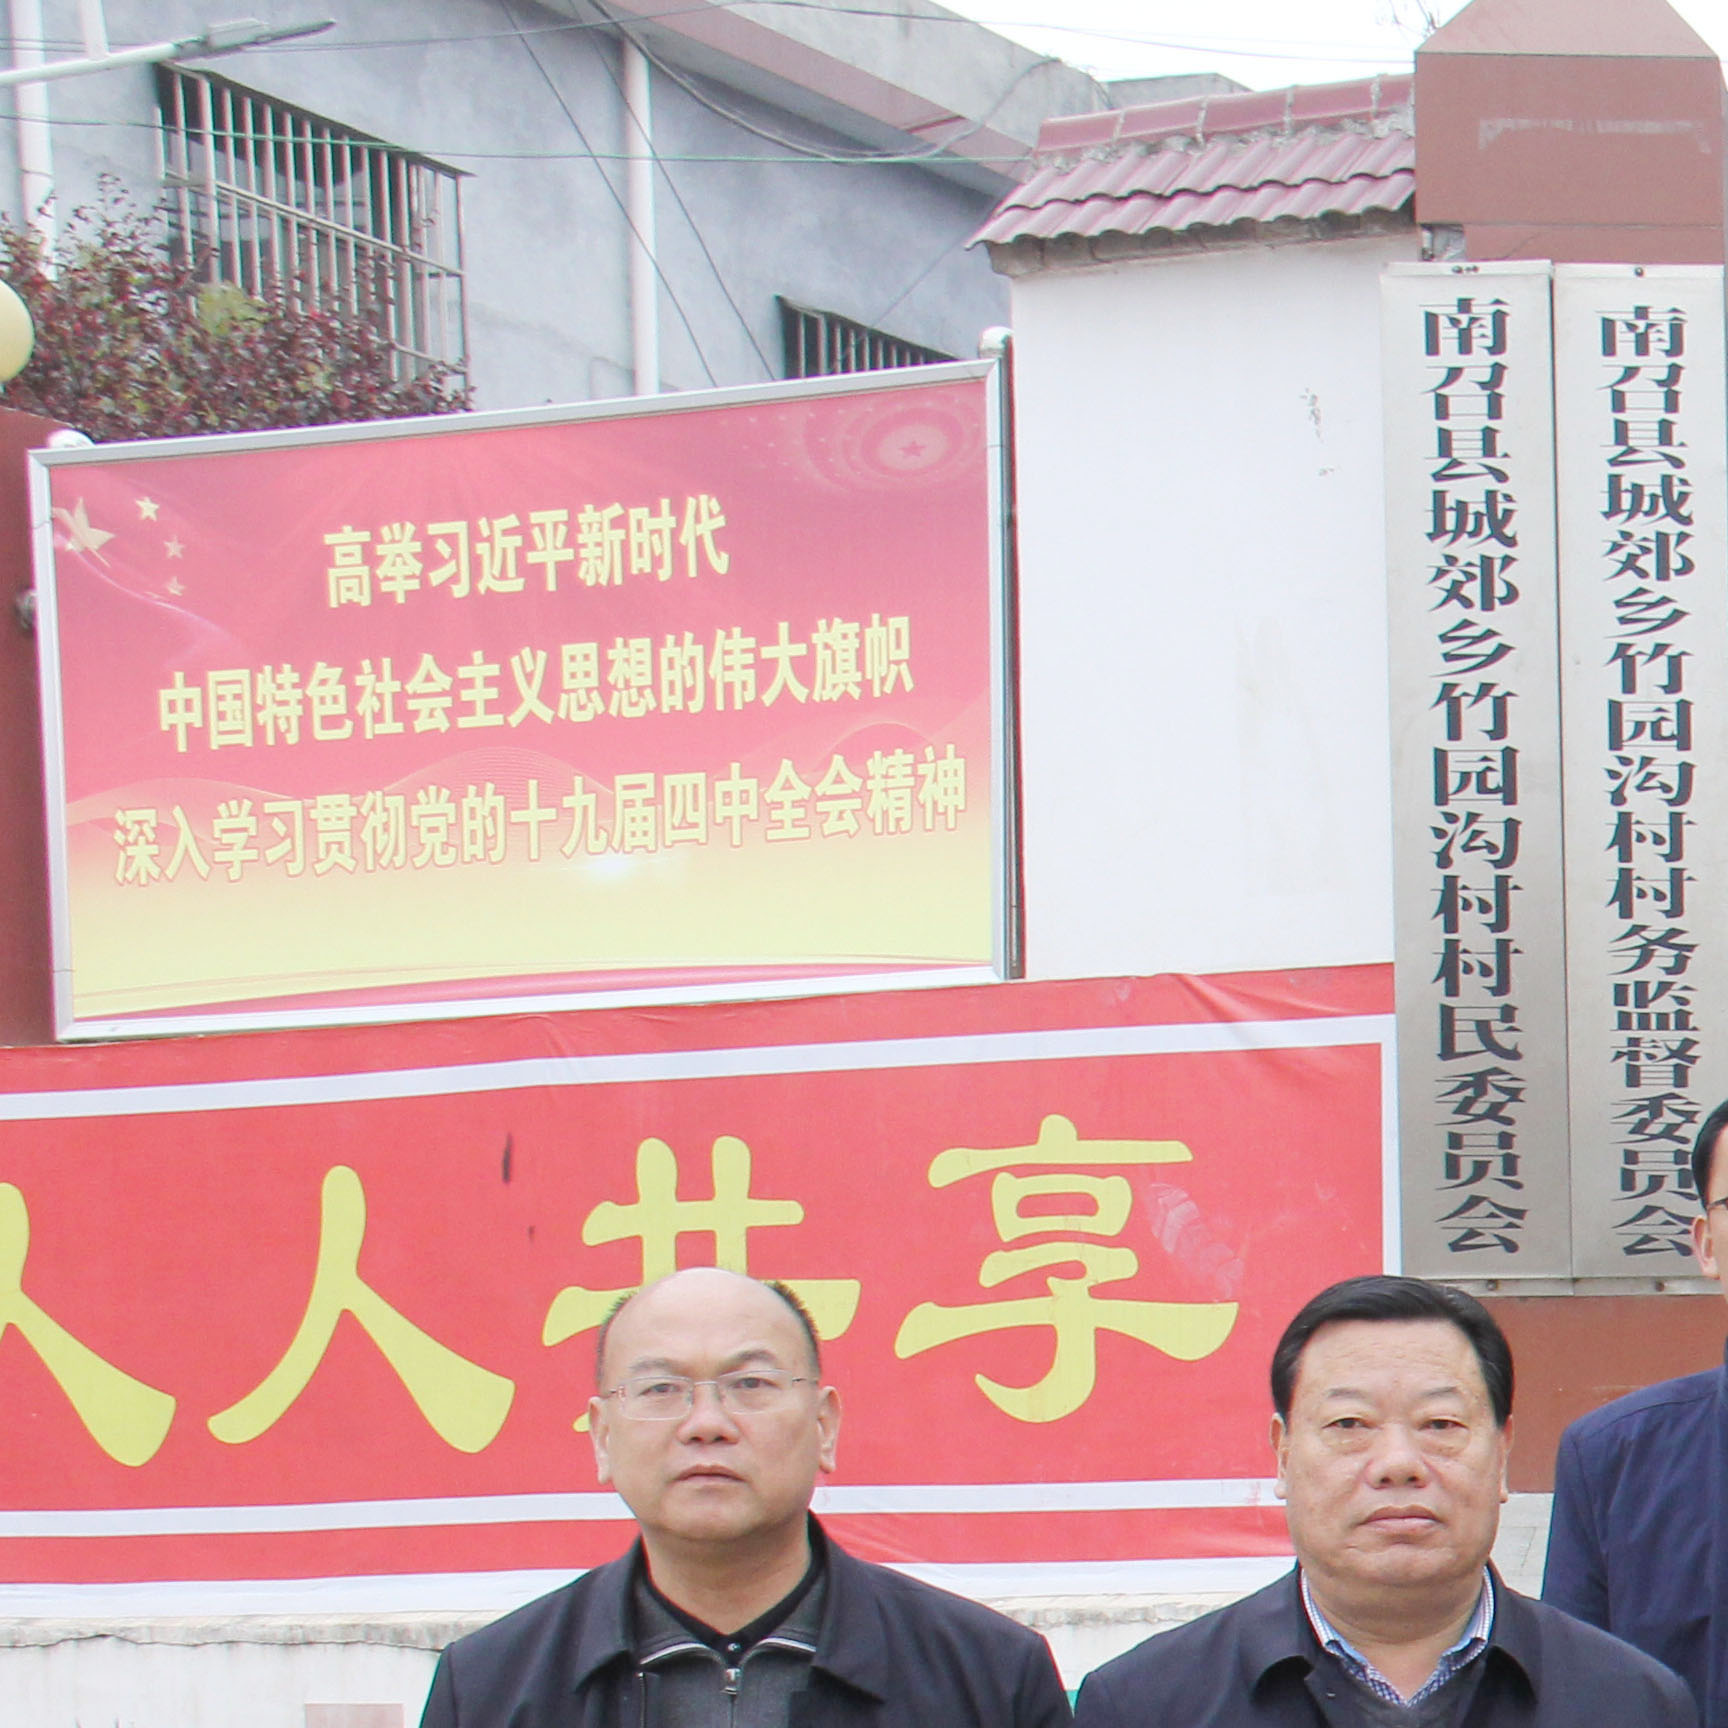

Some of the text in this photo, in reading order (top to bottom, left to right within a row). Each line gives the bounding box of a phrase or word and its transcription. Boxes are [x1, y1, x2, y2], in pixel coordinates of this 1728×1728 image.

[324, 493, 730, 608] 高举习近平新时代
[157, 612, 916, 753] 中国特色社会主义思想的伟大旗帜
[112, 744, 967, 888] 深入学习贯彻党的十九届四中全会精神
[1419, 297, 1528, 1254] 南召县城郊乡竹园沟村村民委员会
[1596, 305, 1702, 1257] 南召县城郊乡竹园沟村村务监督委员会
